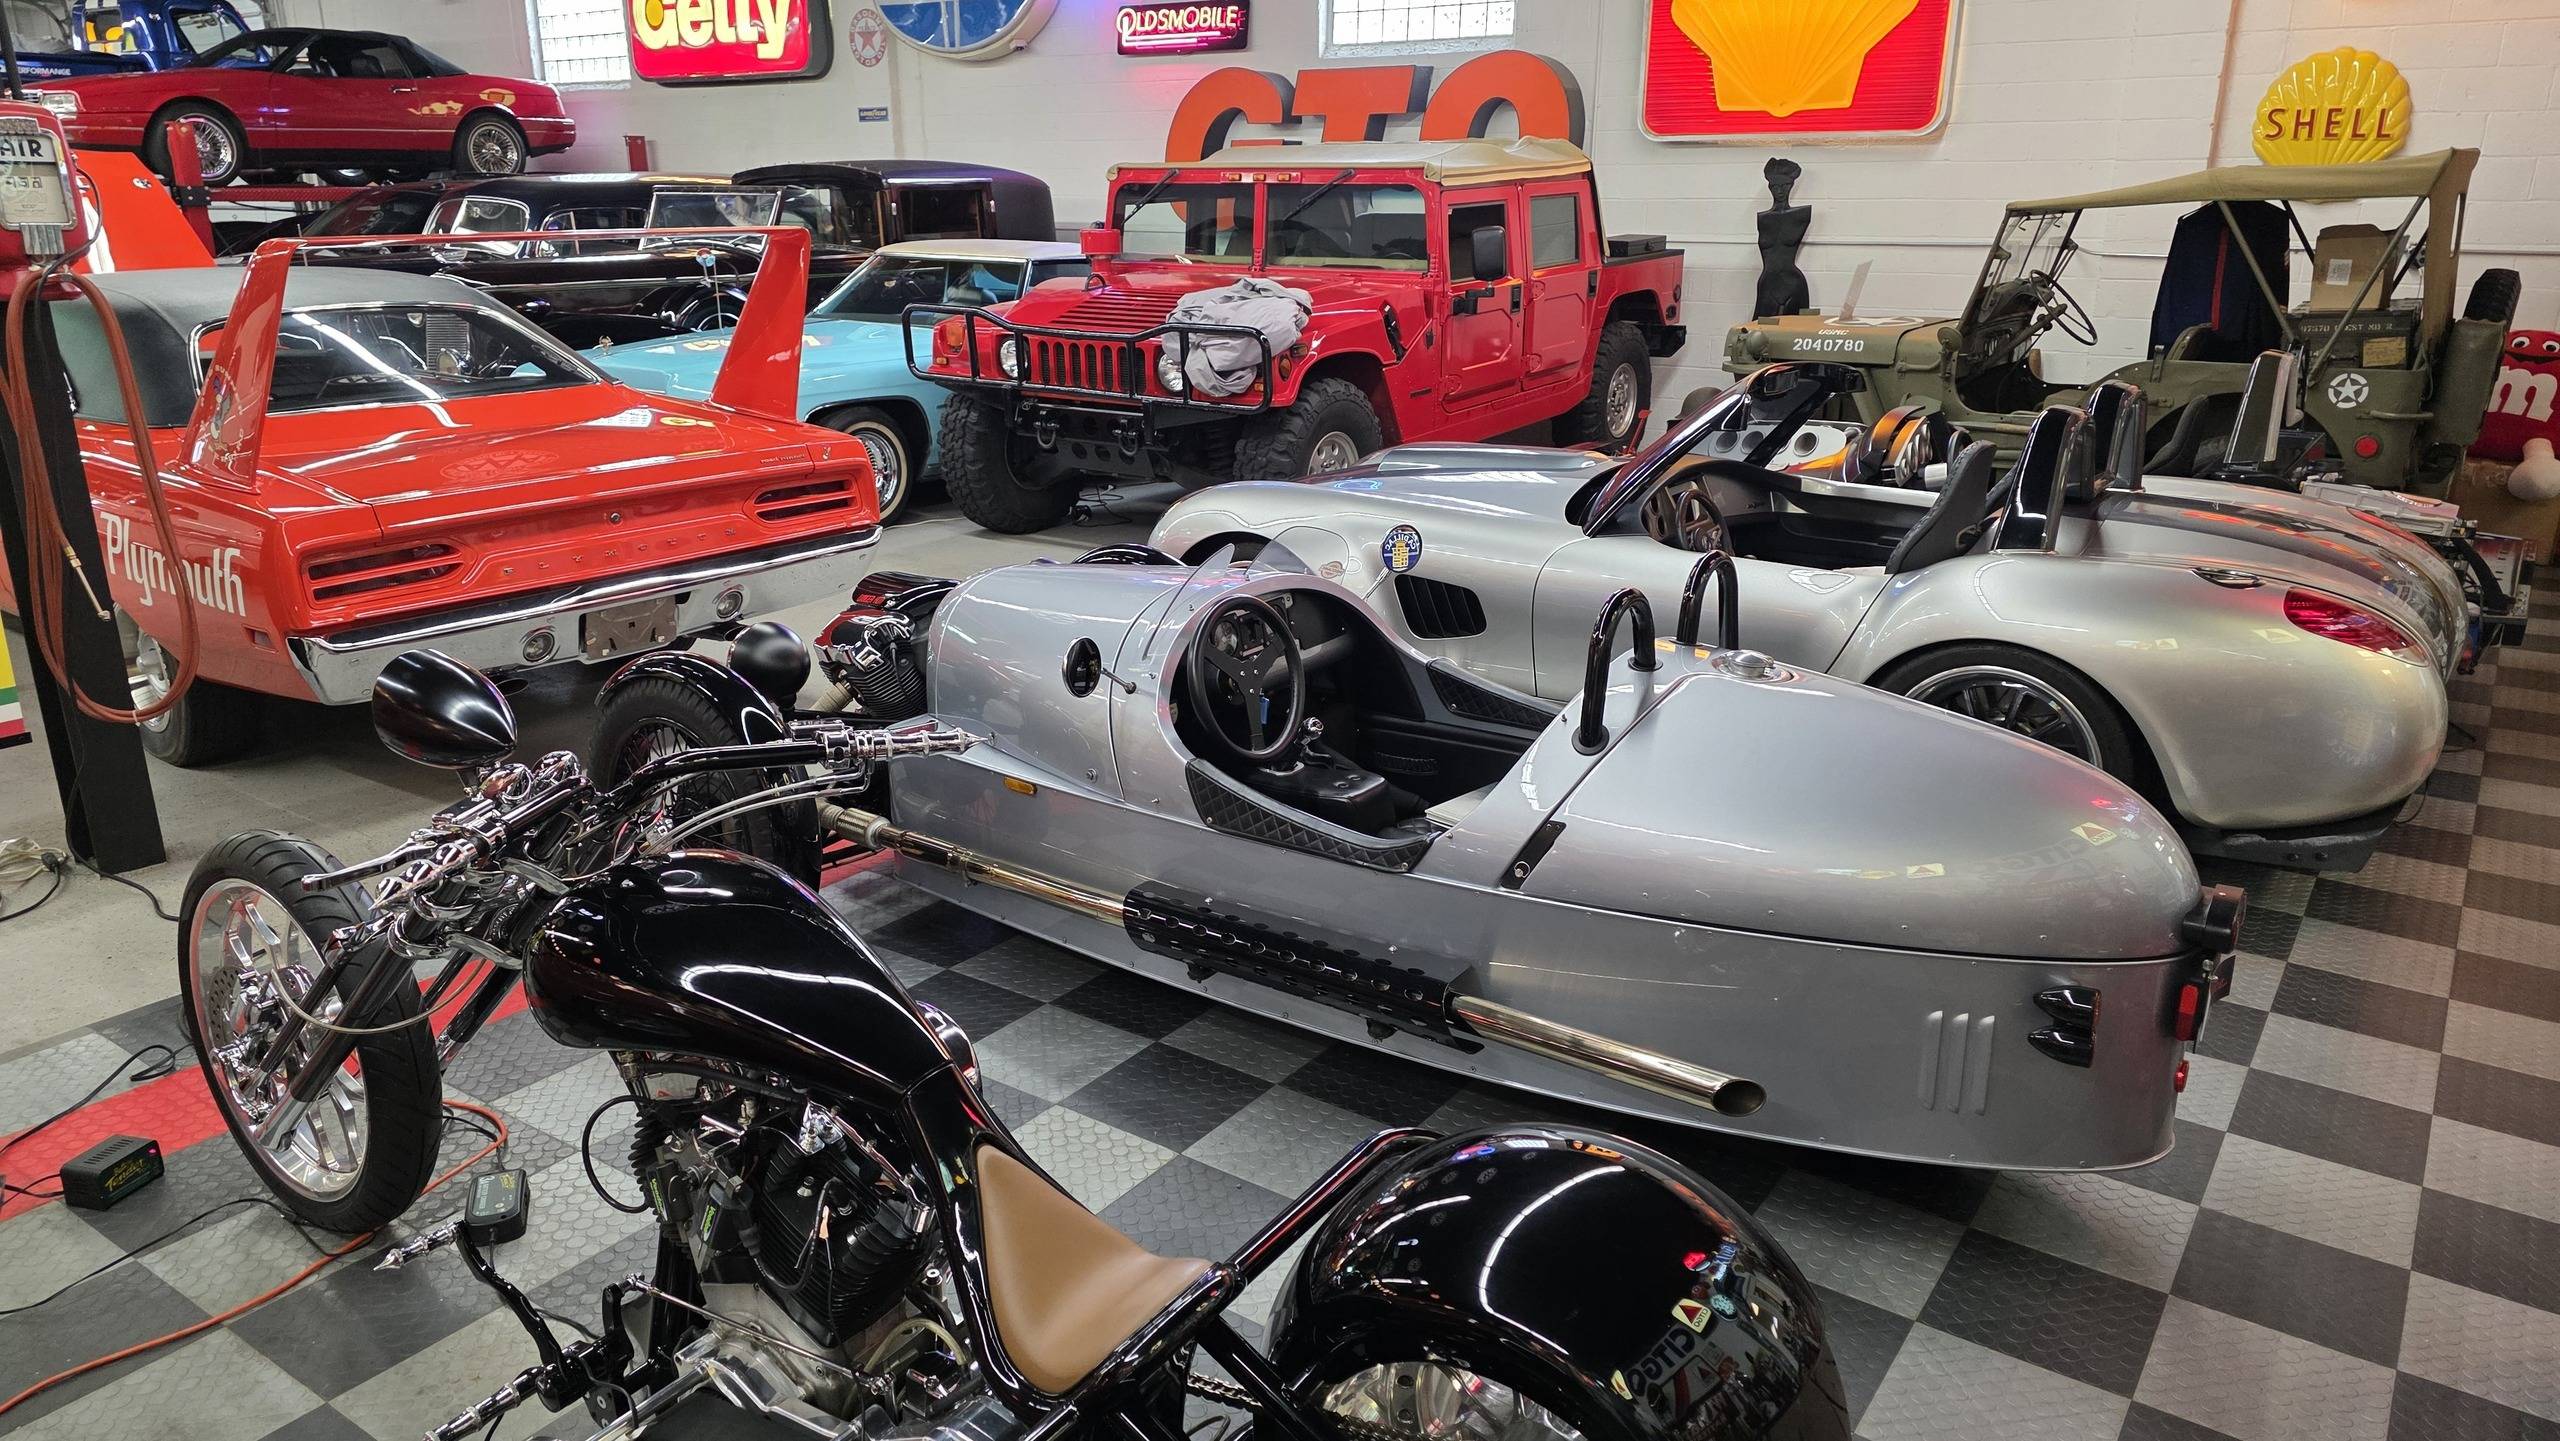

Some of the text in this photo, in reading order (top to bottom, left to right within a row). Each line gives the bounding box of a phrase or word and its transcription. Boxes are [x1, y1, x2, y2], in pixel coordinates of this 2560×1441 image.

[1116, 6, 1239, 35] OLDSMOBILE
[17, 66, 72, 76] ERFORMANCE
[2264, 107, 2395, 141] SHELL
[0, 138, 44, 158] AIR
[1818, 328, 1850, 336] USMC
[1792, 338, 1865, 353] 2040780
[2487, 366, 2558, 422] m
